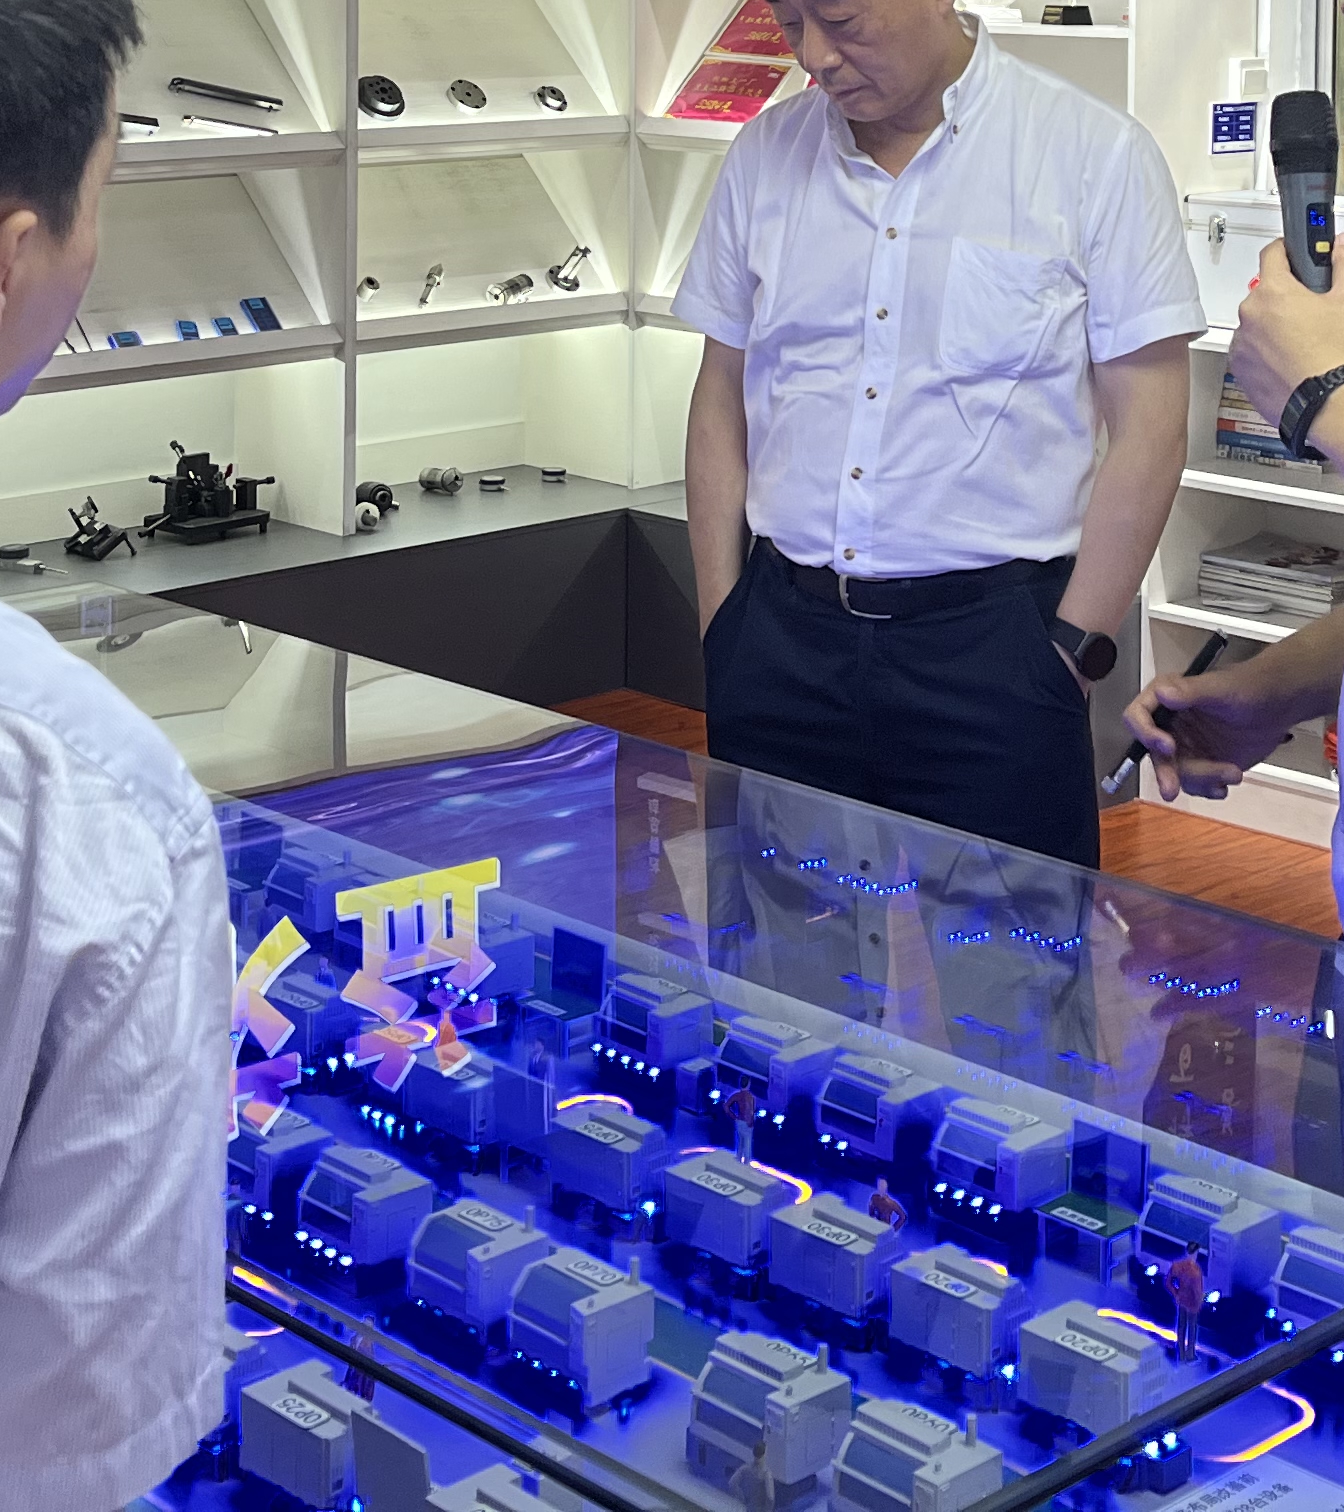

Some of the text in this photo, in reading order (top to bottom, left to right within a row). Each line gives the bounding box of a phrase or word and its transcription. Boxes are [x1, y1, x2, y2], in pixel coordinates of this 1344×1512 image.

[582, 1123, 618, 1142] OP25
[696, 1173, 737, 1194] OP30
[465, 1207, 503, 1228] OP75
[808, 1222, 850, 1243] OP30
[573, 1260, 617, 1283] OP70
[924, 1272, 971, 1295] OP20
[1060, 1333, 1111, 1358] OP20
[275, 1397, 323, 1424] OP25
